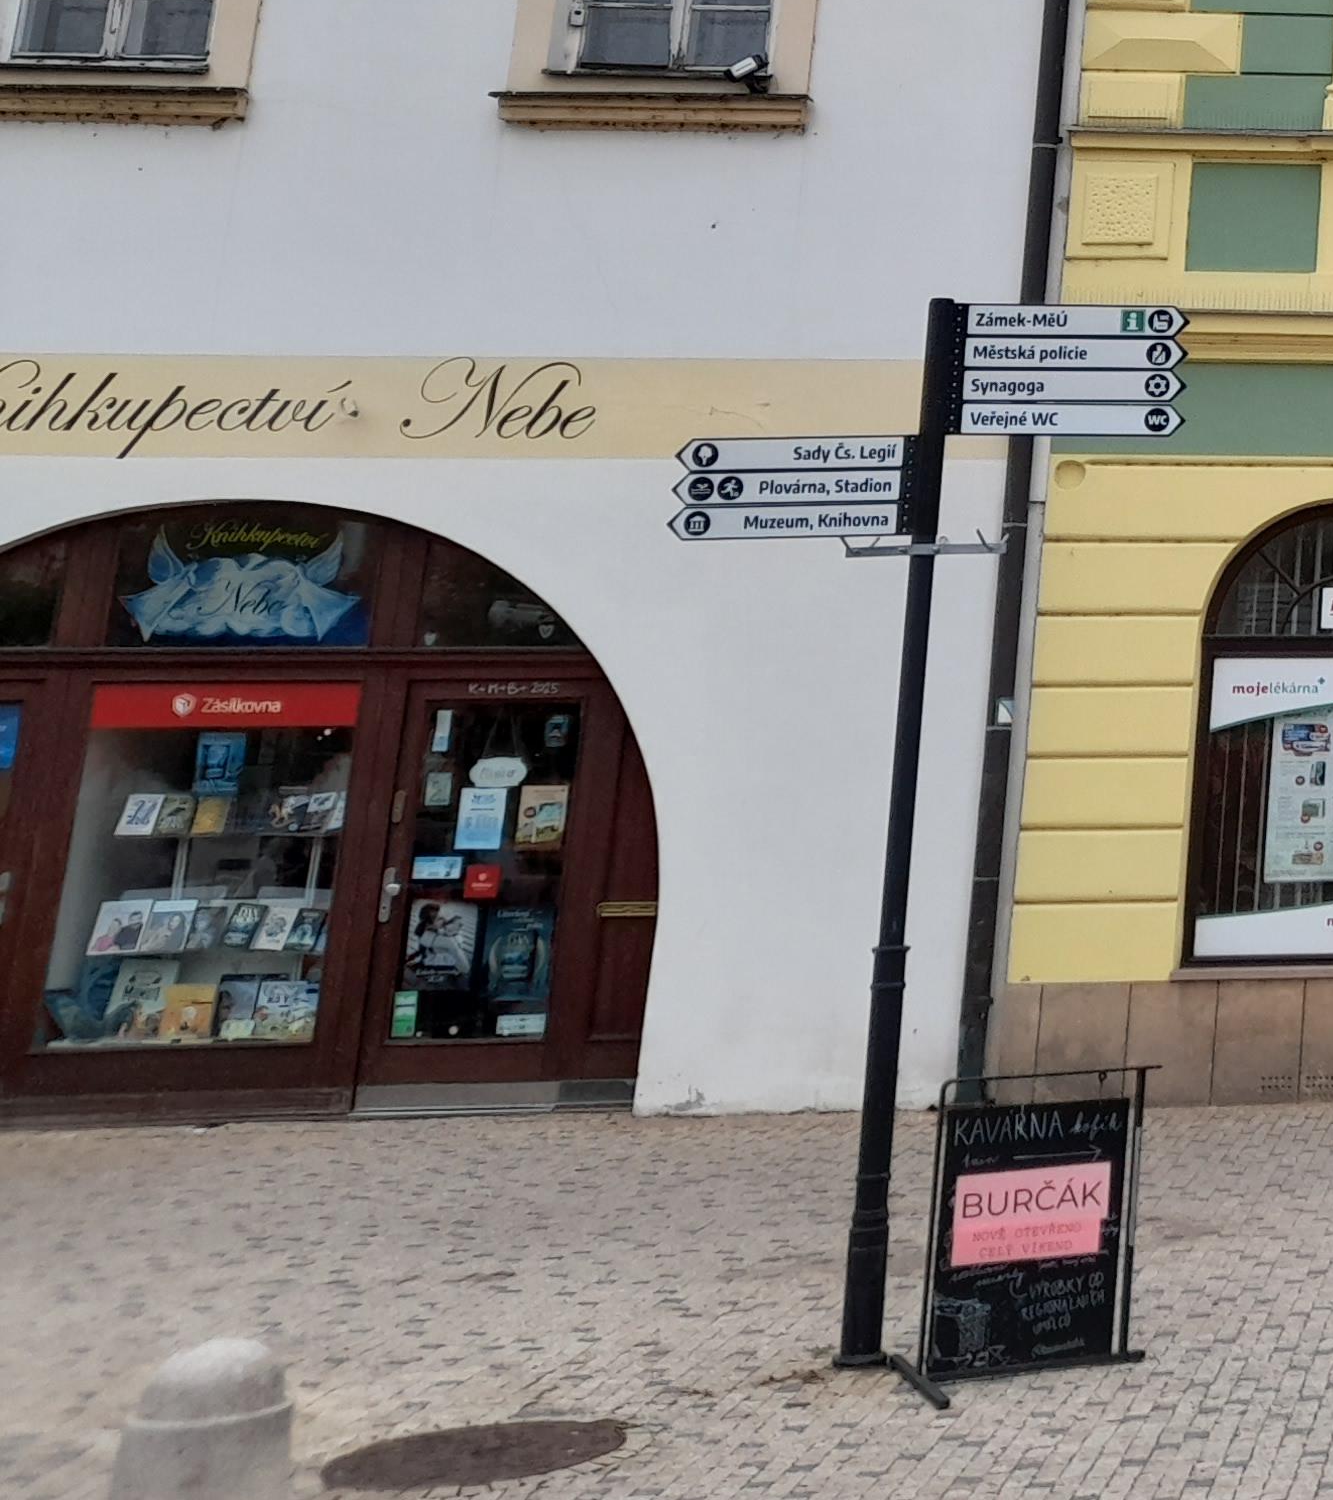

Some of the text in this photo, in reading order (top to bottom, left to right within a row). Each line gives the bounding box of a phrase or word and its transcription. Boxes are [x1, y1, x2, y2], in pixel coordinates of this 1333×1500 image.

[976, 310, 1068, 328] Zámek-MěÚ
[973, 343, 1088, 363] Městská policie
[971, 378, 1045, 397] Synagoga
[0, 356, 597, 459] ihkupectví Nebe
[970, 410, 1168, 430] Veřejné WC WC
[793, 442, 897, 463] Sady Čs. Legií
[758, 477, 892, 498] Plovárna, Stadion
[743, 512, 889, 533] Muzeum, Knihovna
[198, 578, 288, 616] Nebe
[1232, 681, 1319, 697] mojelékárna
[201, 697, 282, 714] Zásilkovna
[961, 1177, 1103, 1218] BURČÁK
